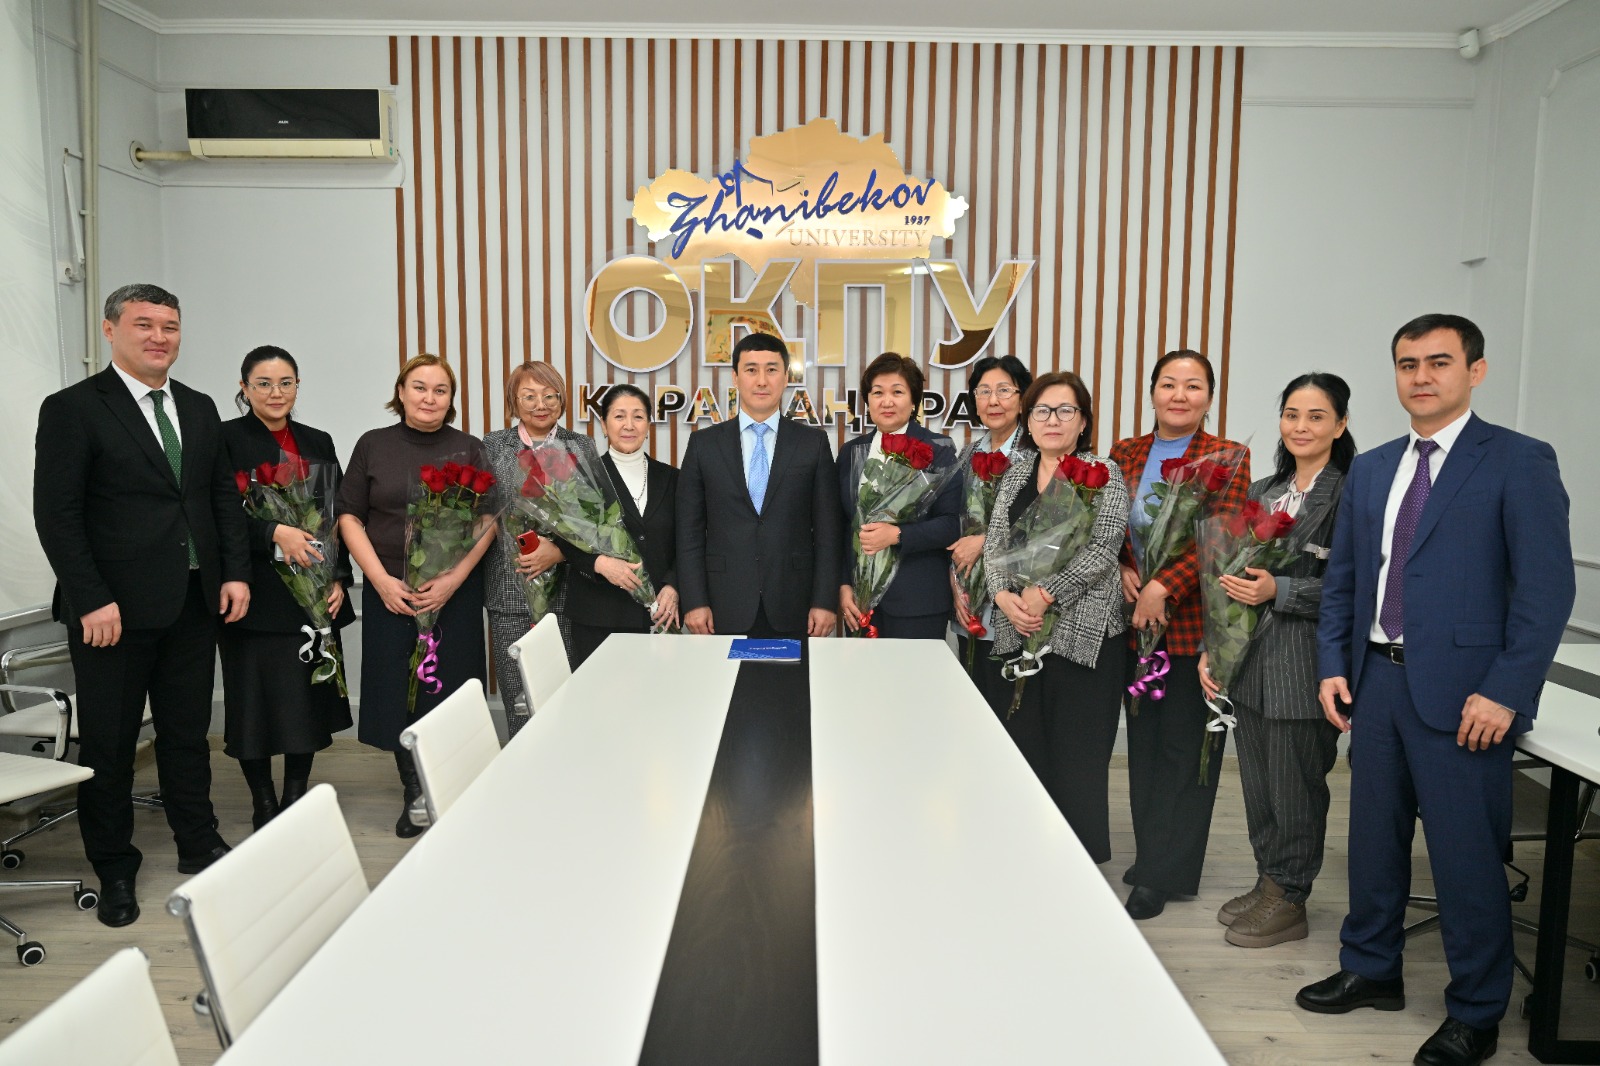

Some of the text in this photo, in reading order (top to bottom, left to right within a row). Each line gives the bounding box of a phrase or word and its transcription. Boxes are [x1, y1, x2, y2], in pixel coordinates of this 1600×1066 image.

[667, 168, 936, 259] Zhanibekov
[904, 215, 931, 226] 1937
[787, 228, 928, 247] UNIVERSITY
